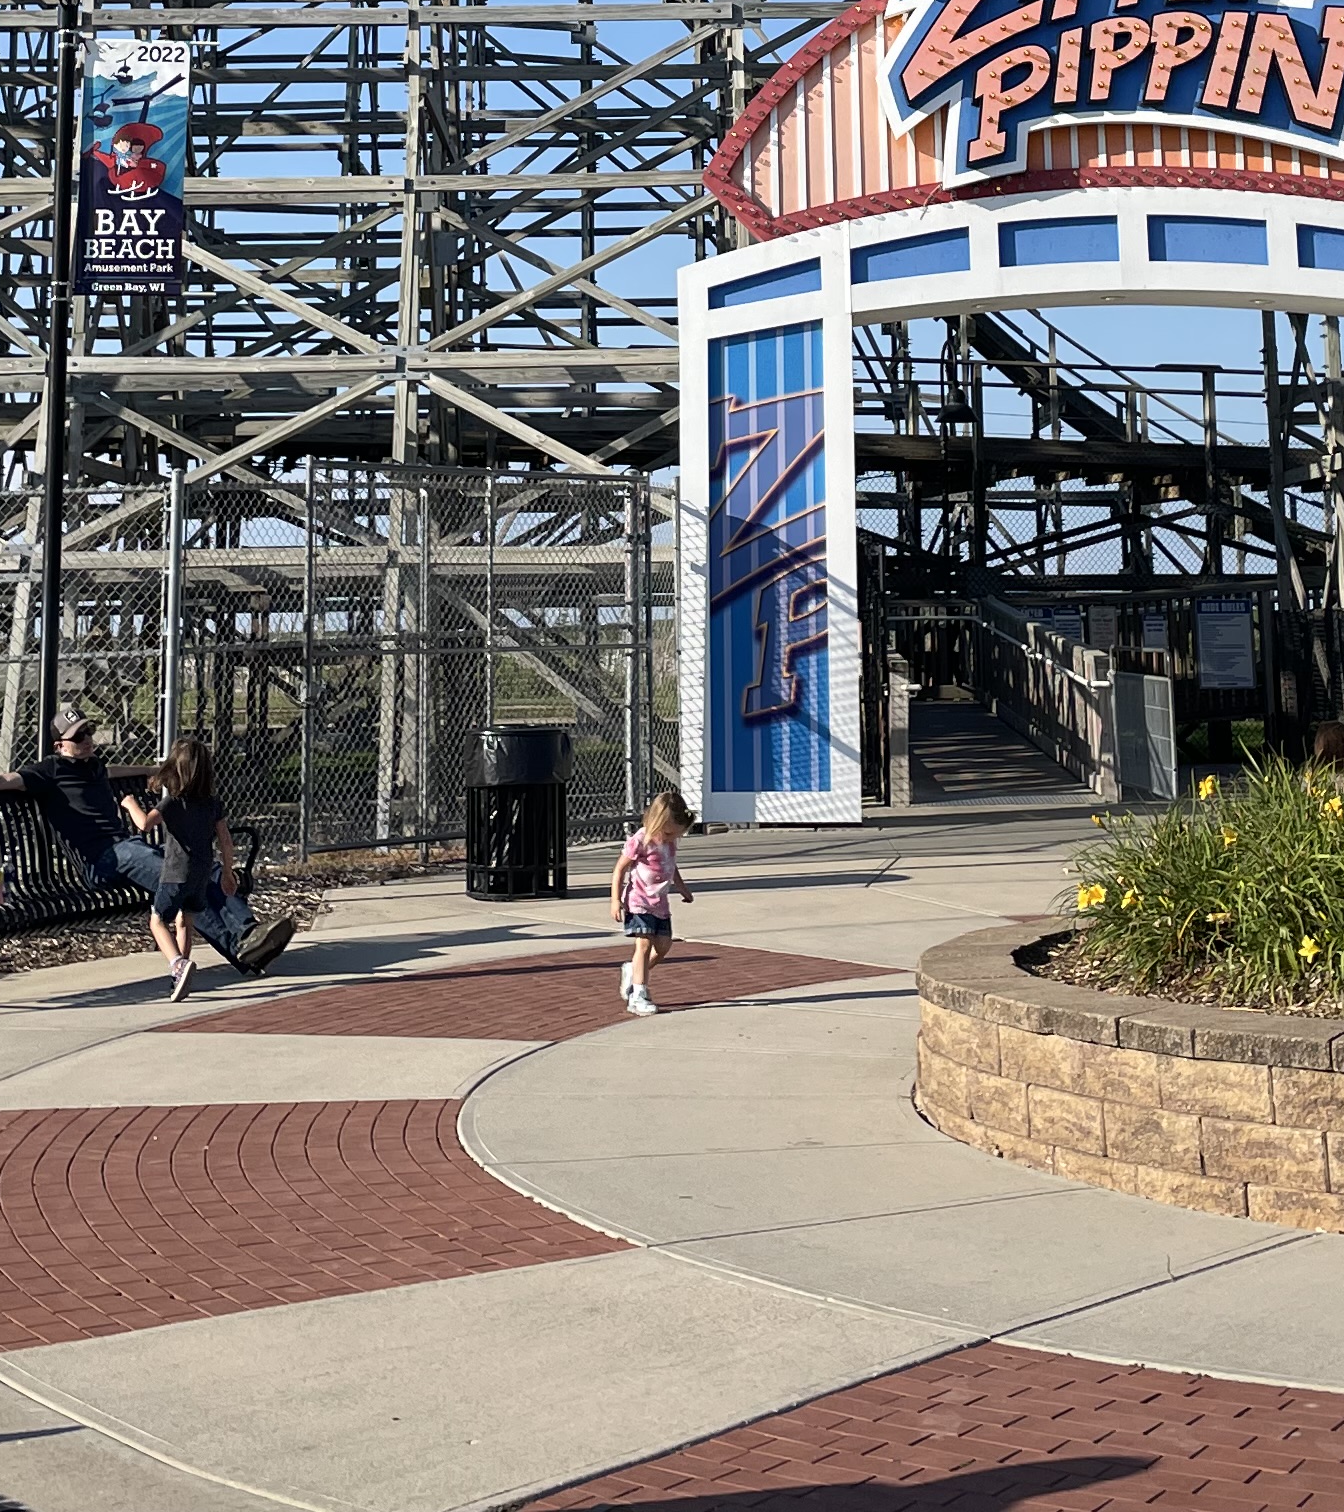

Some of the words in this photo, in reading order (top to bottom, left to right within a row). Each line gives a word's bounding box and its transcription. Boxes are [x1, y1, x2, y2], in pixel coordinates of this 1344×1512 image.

[137, 45, 186, 63] 2022
[94, 209, 166, 236] BAY
[83, 238, 175, 259] BEACH
[83, 263, 148, 273] Amusement
[149, 263, 174, 273] Park
[91, 283, 123, 292] Green
[149, 283, 165, 292] WI
